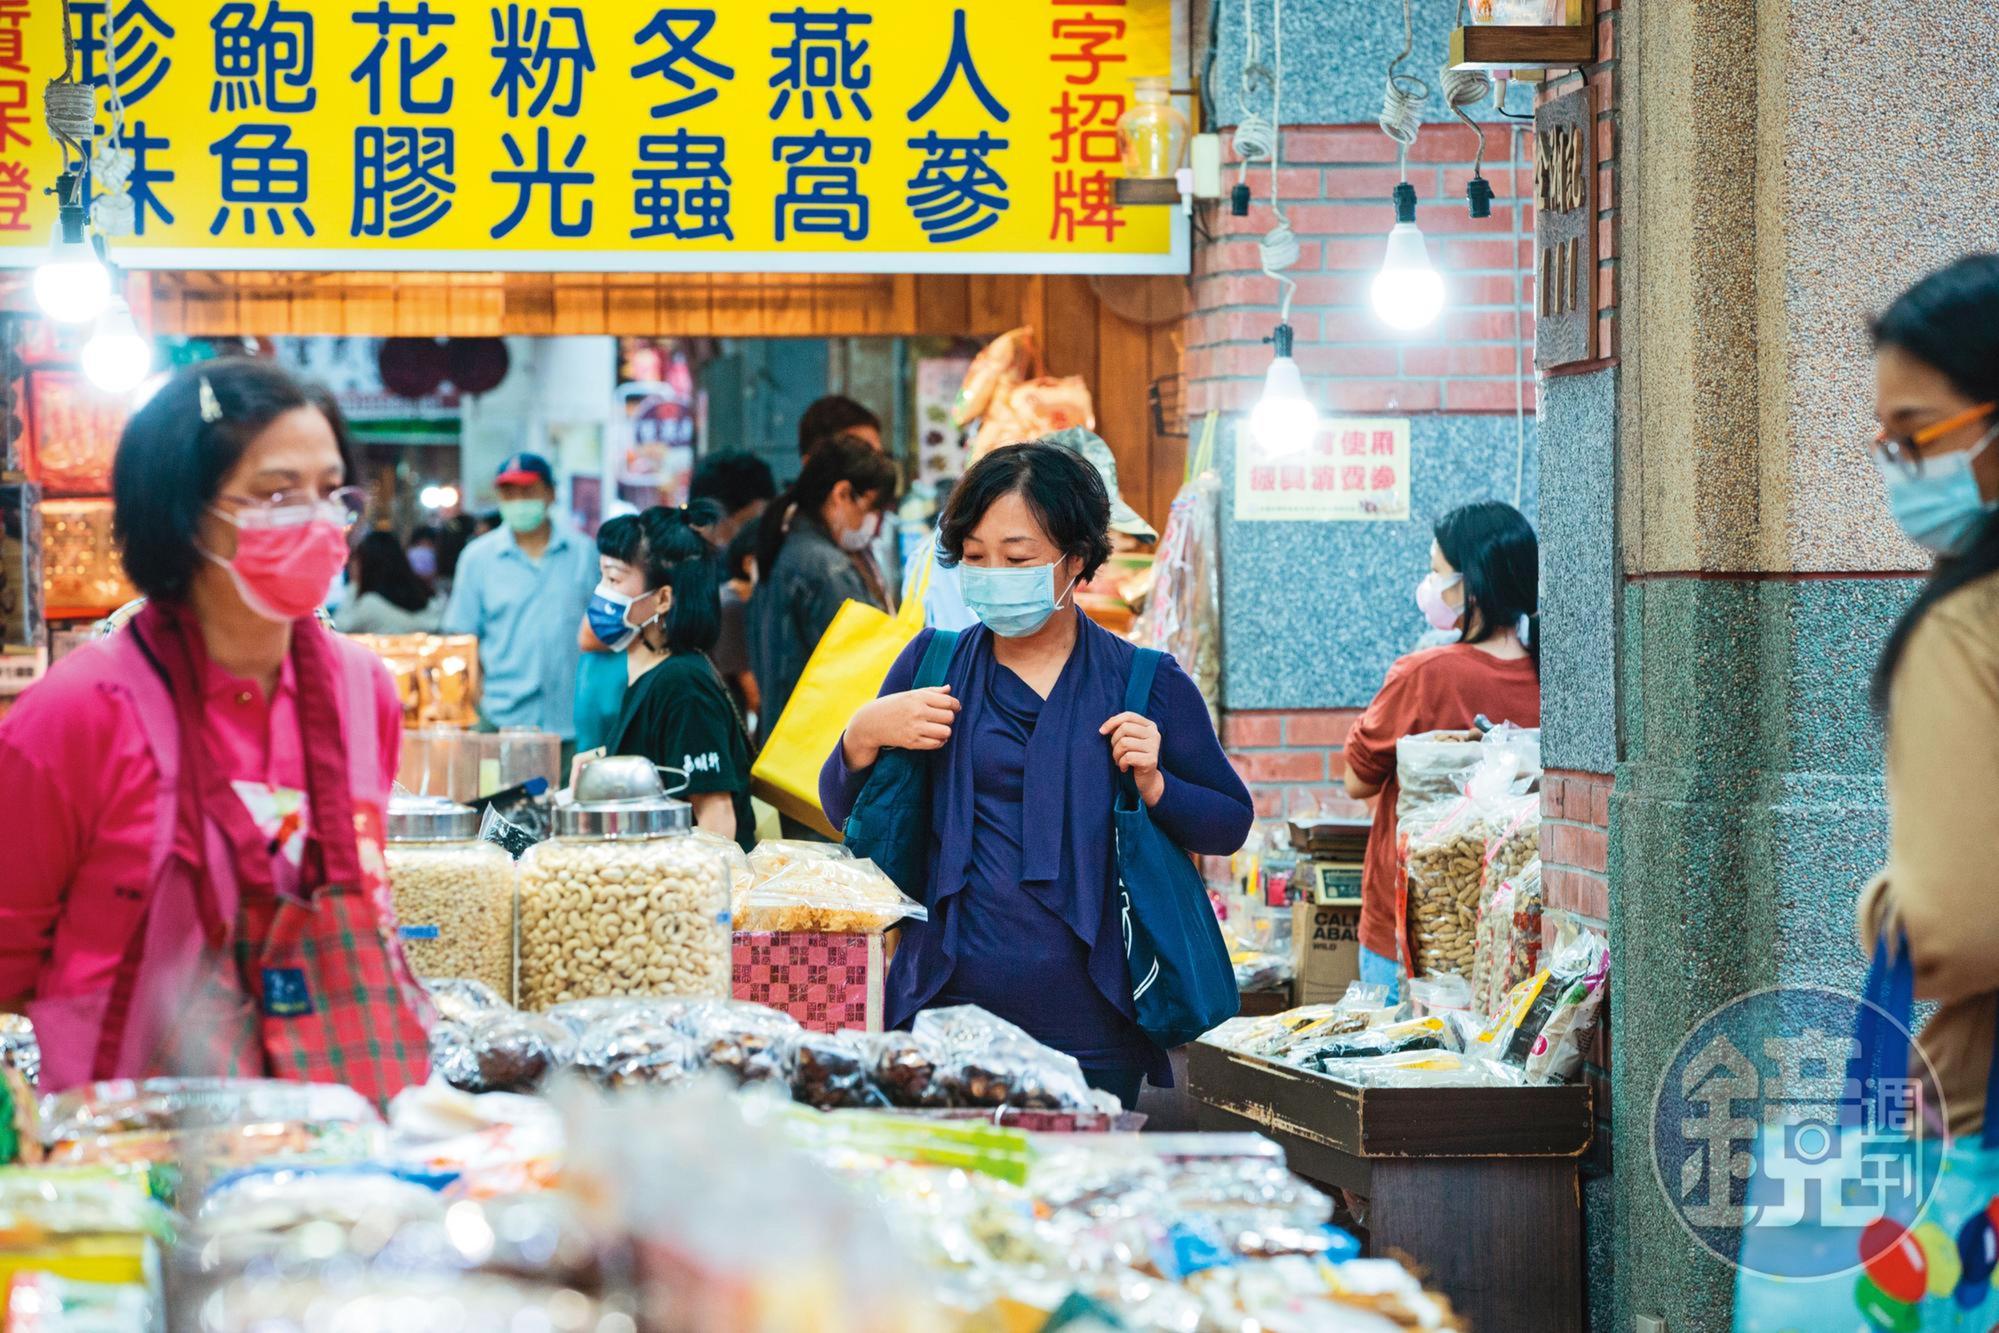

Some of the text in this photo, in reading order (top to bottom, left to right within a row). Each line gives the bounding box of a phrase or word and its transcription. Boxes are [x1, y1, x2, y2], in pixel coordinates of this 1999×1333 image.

[209, 1, 316, 237] 鮑魚
[351, 2, 455, 238] 花膠
[491, 4, 595, 239] 粉光
[631, 9, 734, 240] 冬蟲
[769, 8, 871, 241] 燕窩
[906, 10, 1009, 243] 人蔘
[1050, 0, 1127, 242] 字招牌
